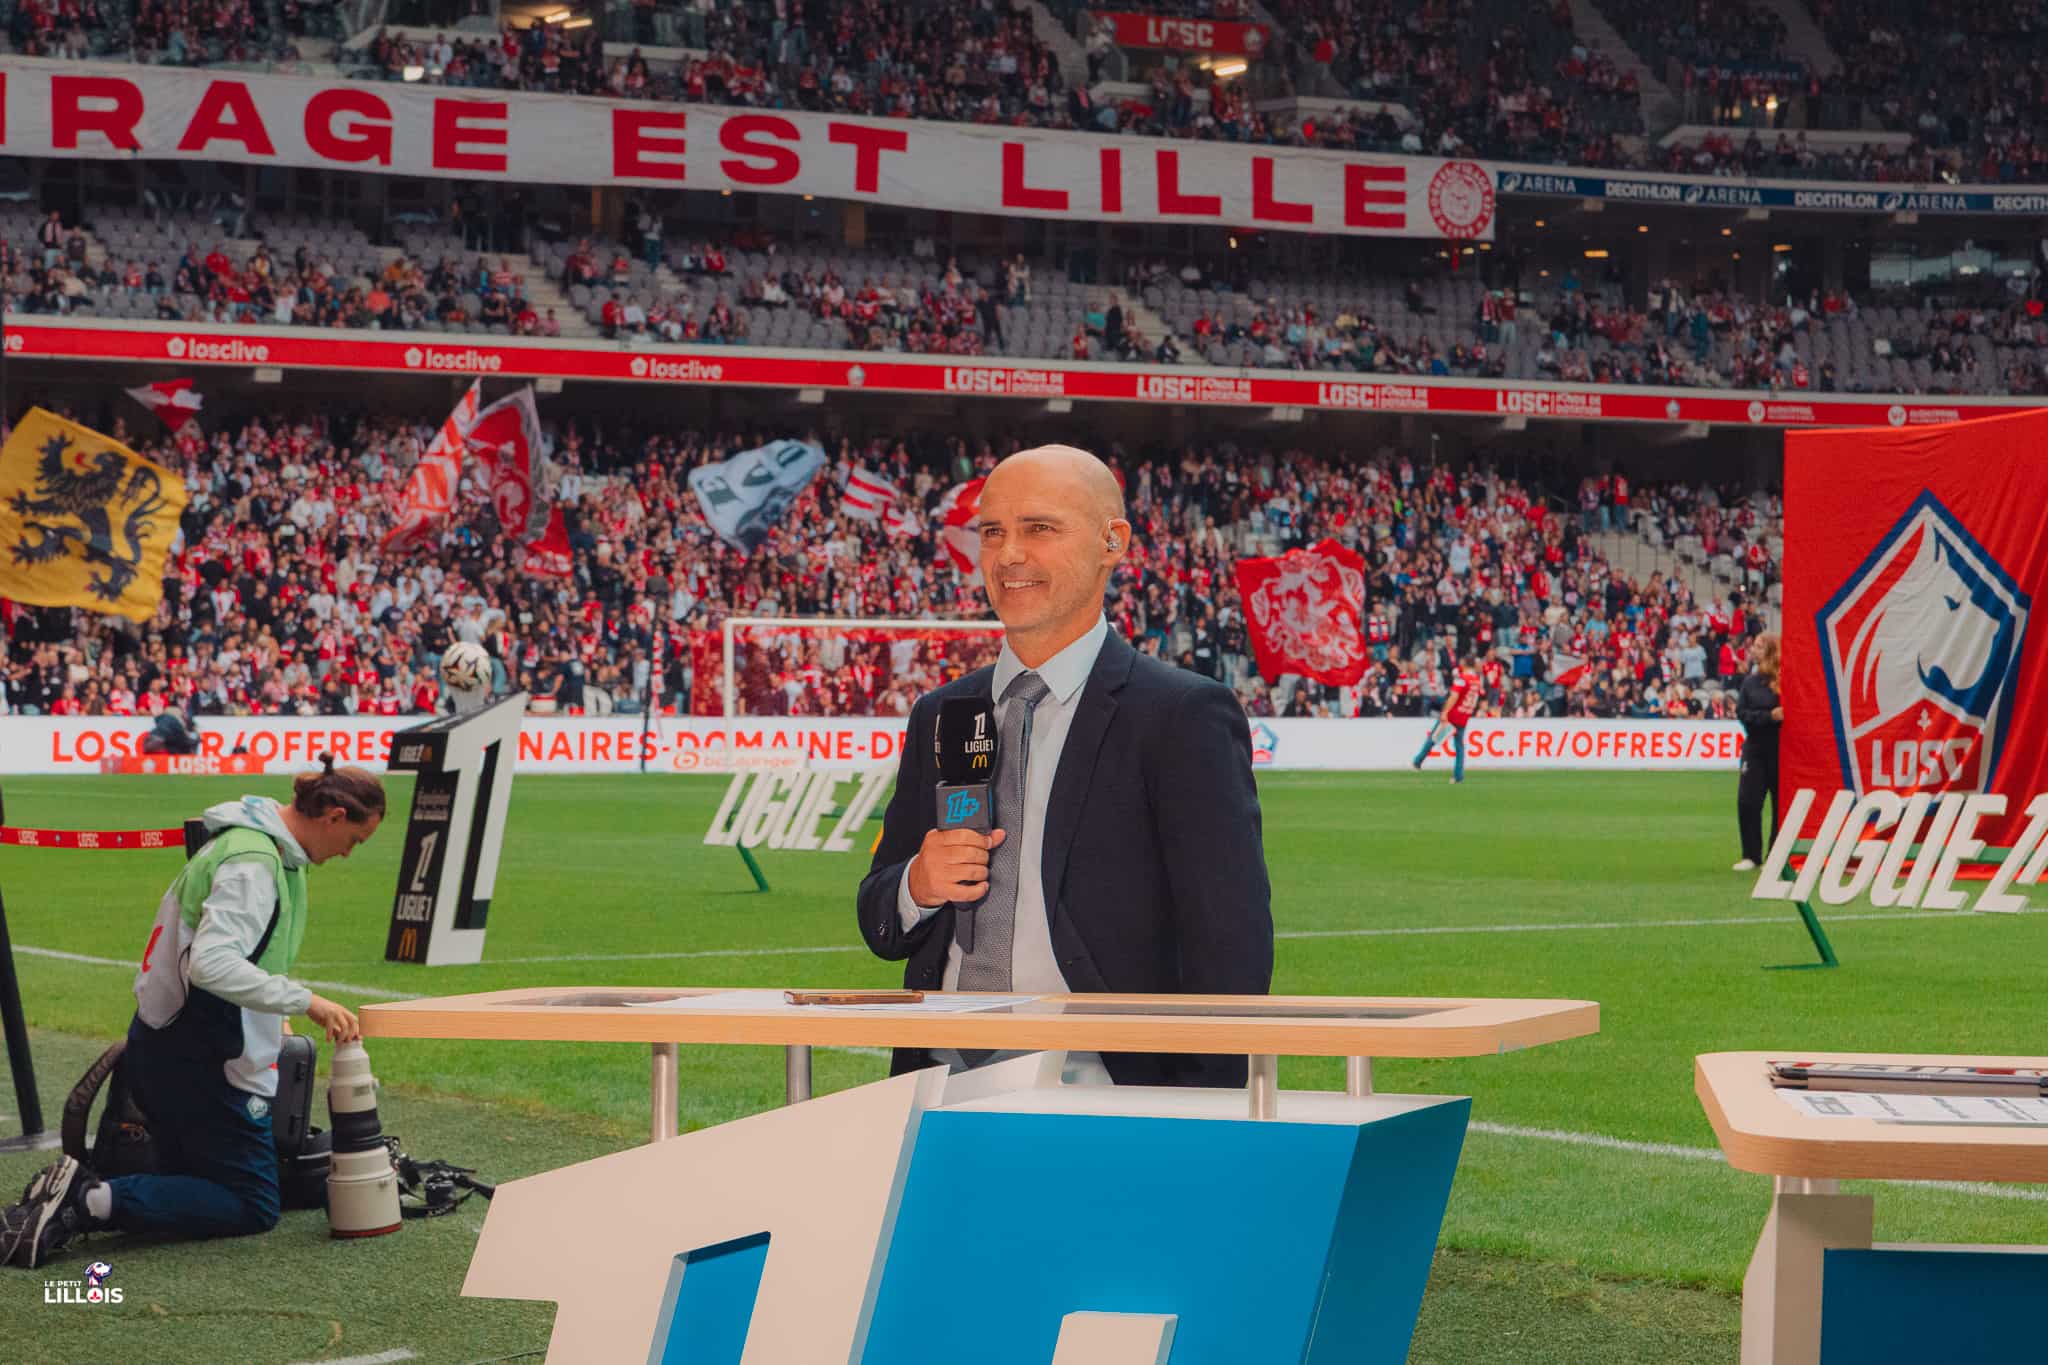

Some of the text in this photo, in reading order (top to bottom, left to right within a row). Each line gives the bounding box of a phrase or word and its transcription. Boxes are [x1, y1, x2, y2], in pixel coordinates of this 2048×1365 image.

[612, 109, 908, 194] EST
[1002, 142, 1406, 229] LILLE
[1523, 175, 1577, 193] ARENA
[1605, 181, 1762, 203] DECATHLON ARENA
[1794, 191, 1967, 209] DECATHLON ARENA
[188, 338, 269, 361] losclive
[425, 349, 502, 371] losclive
[650, 359, 723, 380] losclive
[944, 368, 1005, 392] LOSC
[1136, 376, 1195, 399] LOSC
[1318, 384, 1374, 407] LOSC
[1496, 391, 1550, 414] LOSC
[168, 756, 220, 773] LOSC
[1871, 737, 1974, 787] LOSC
[17, 830, 39, 846] LOSC
[77, 832, 99, 848] LOSC
[140, 831, 164, 846] LOSC
